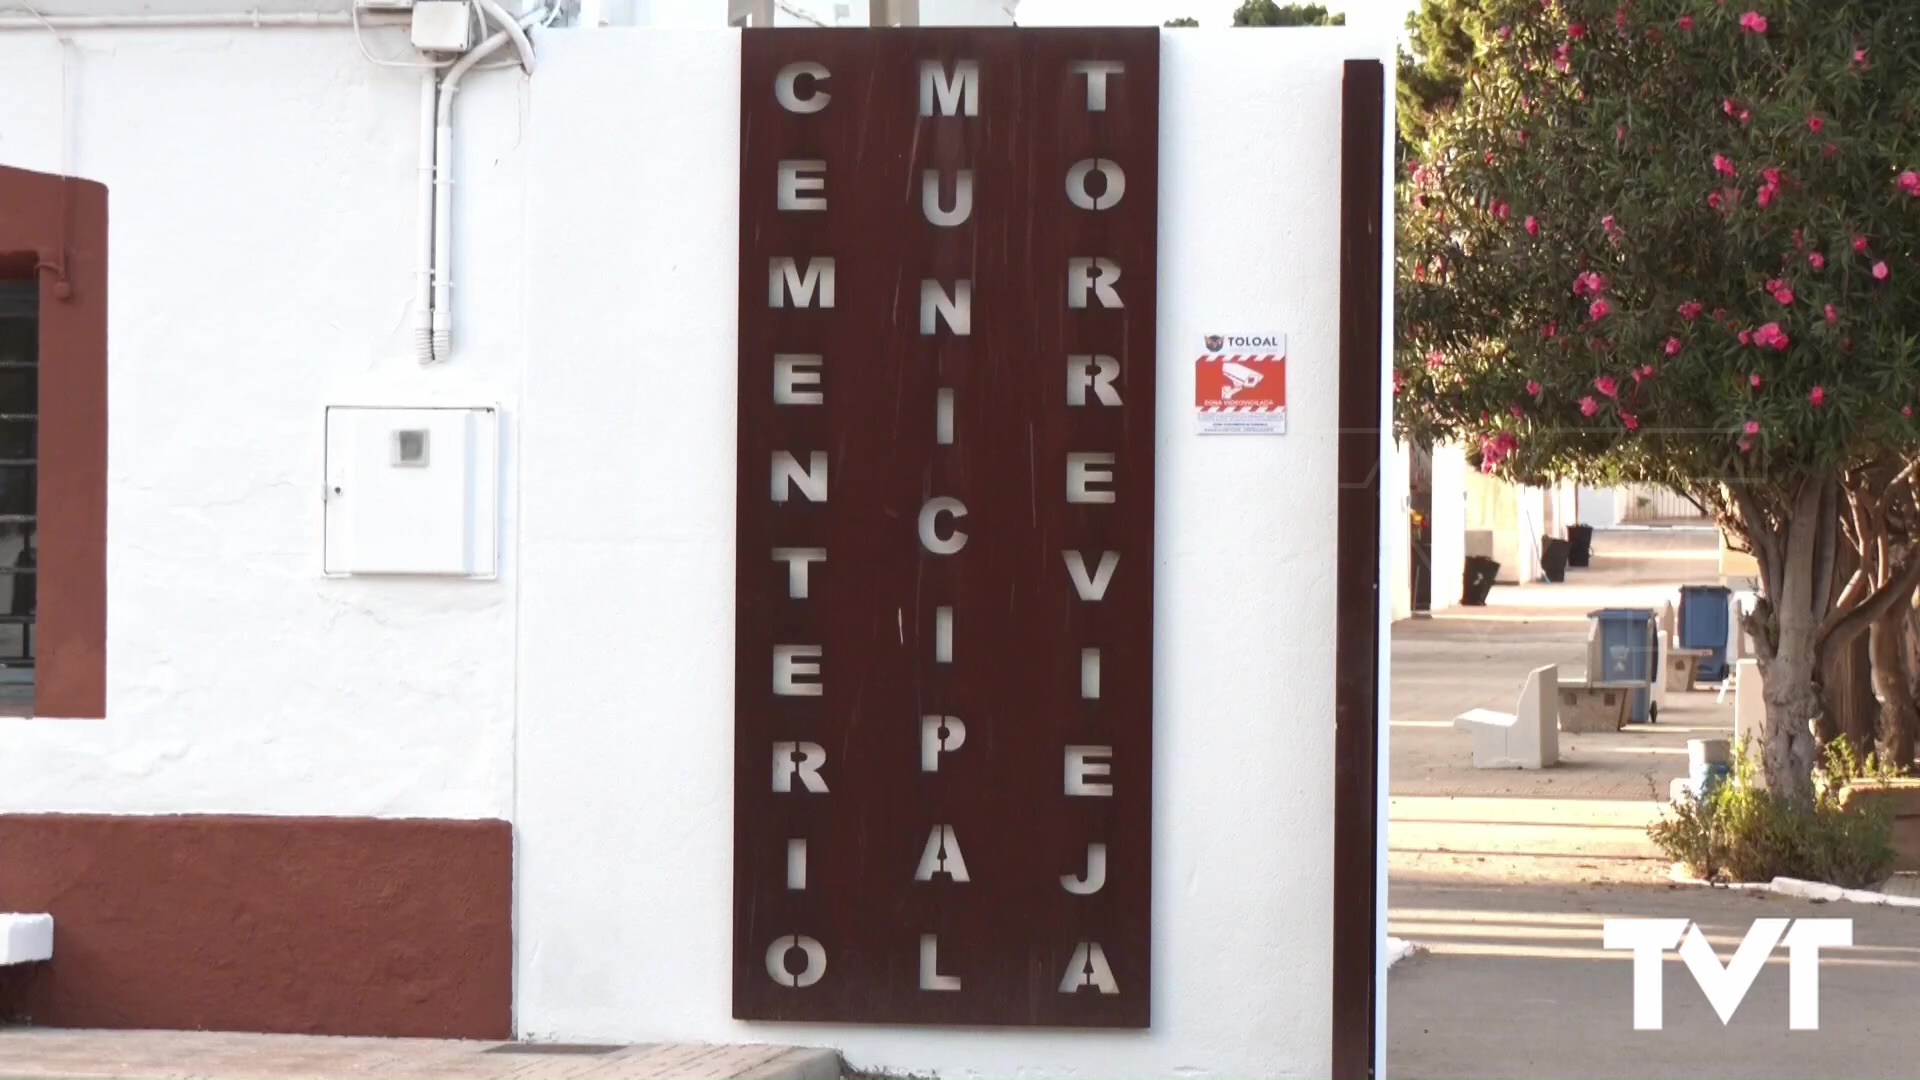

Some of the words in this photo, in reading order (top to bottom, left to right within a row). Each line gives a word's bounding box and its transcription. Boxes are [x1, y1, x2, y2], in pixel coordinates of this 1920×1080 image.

[766, 62, 835, 988] CEMENTERIO
[916, 60, 979, 992] MUNICIPAL
[1061, 62, 1126, 995] TORREVIEJA
[1228, 336, 1278, 346] TOLOAL
